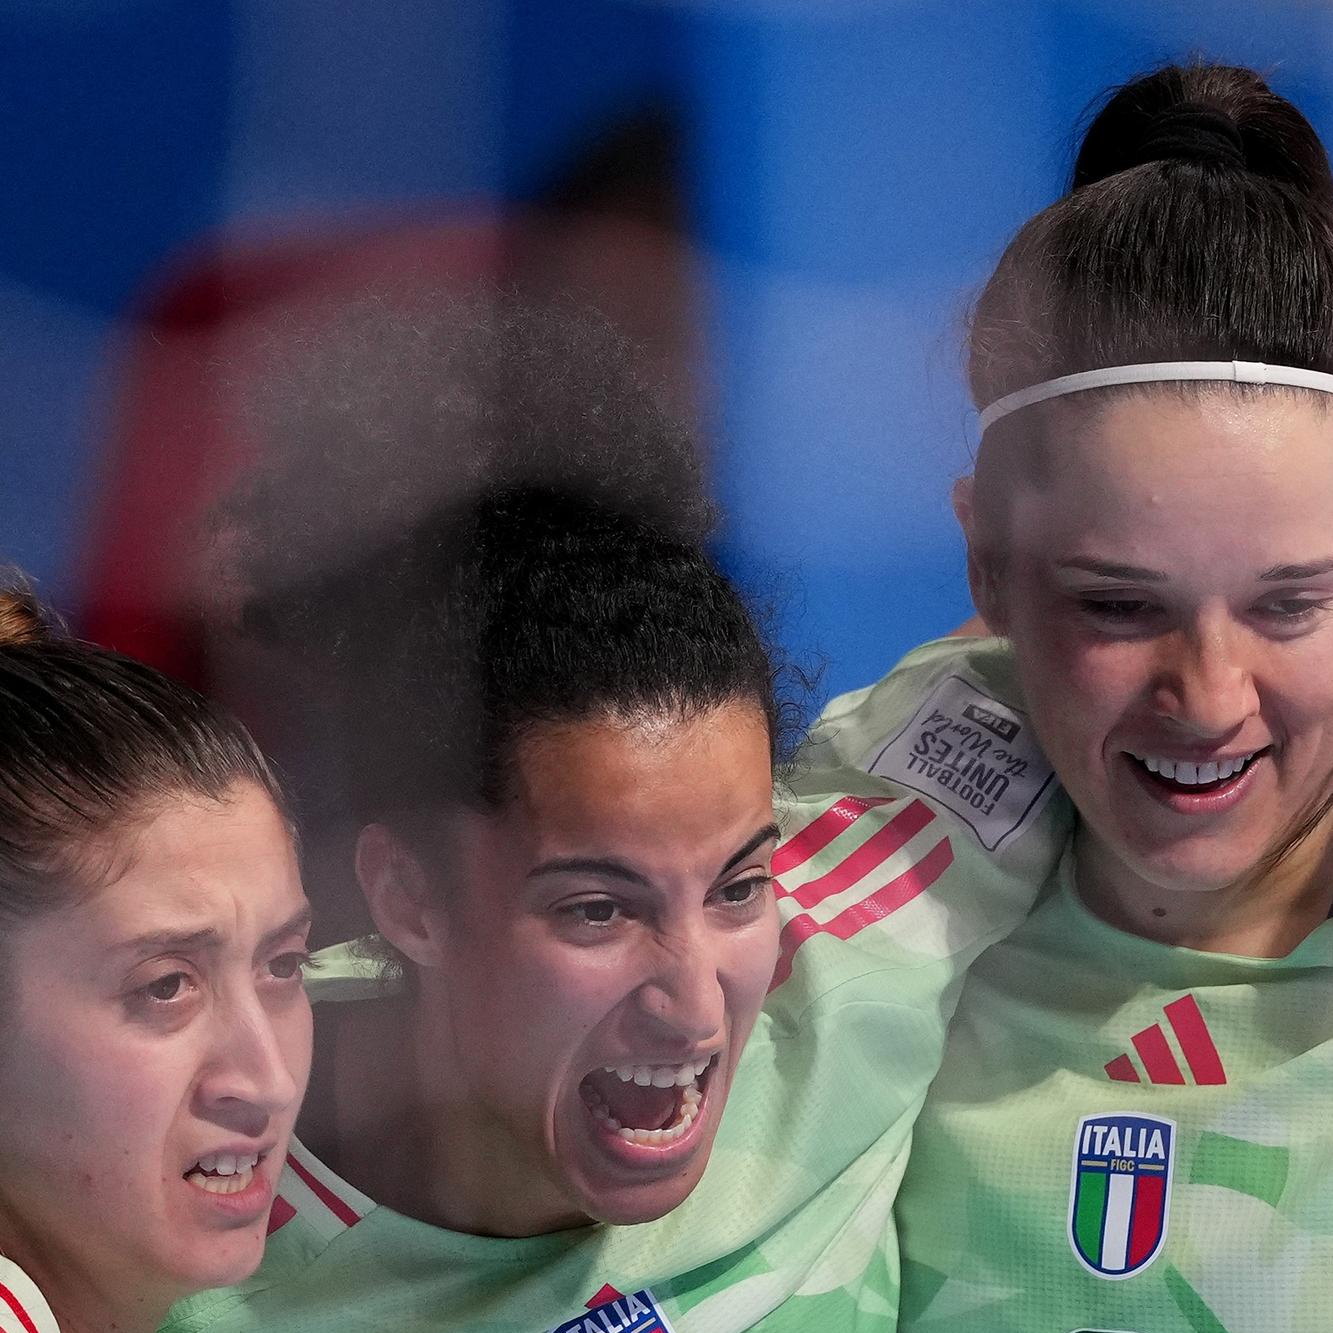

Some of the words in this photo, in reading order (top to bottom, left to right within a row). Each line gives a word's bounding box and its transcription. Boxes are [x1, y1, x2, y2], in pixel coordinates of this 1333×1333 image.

[921, 709, 993, 759] World
[971, 709, 1011, 736] FIFA
[914, 731, 1010, 802] UNITES
[992, 752, 1029, 778] the
[907, 752, 996, 817] FOOTBALL
[1080, 1125, 1167, 1159] ITALIA
[1110, 1159, 1135, 1172] FIGC
